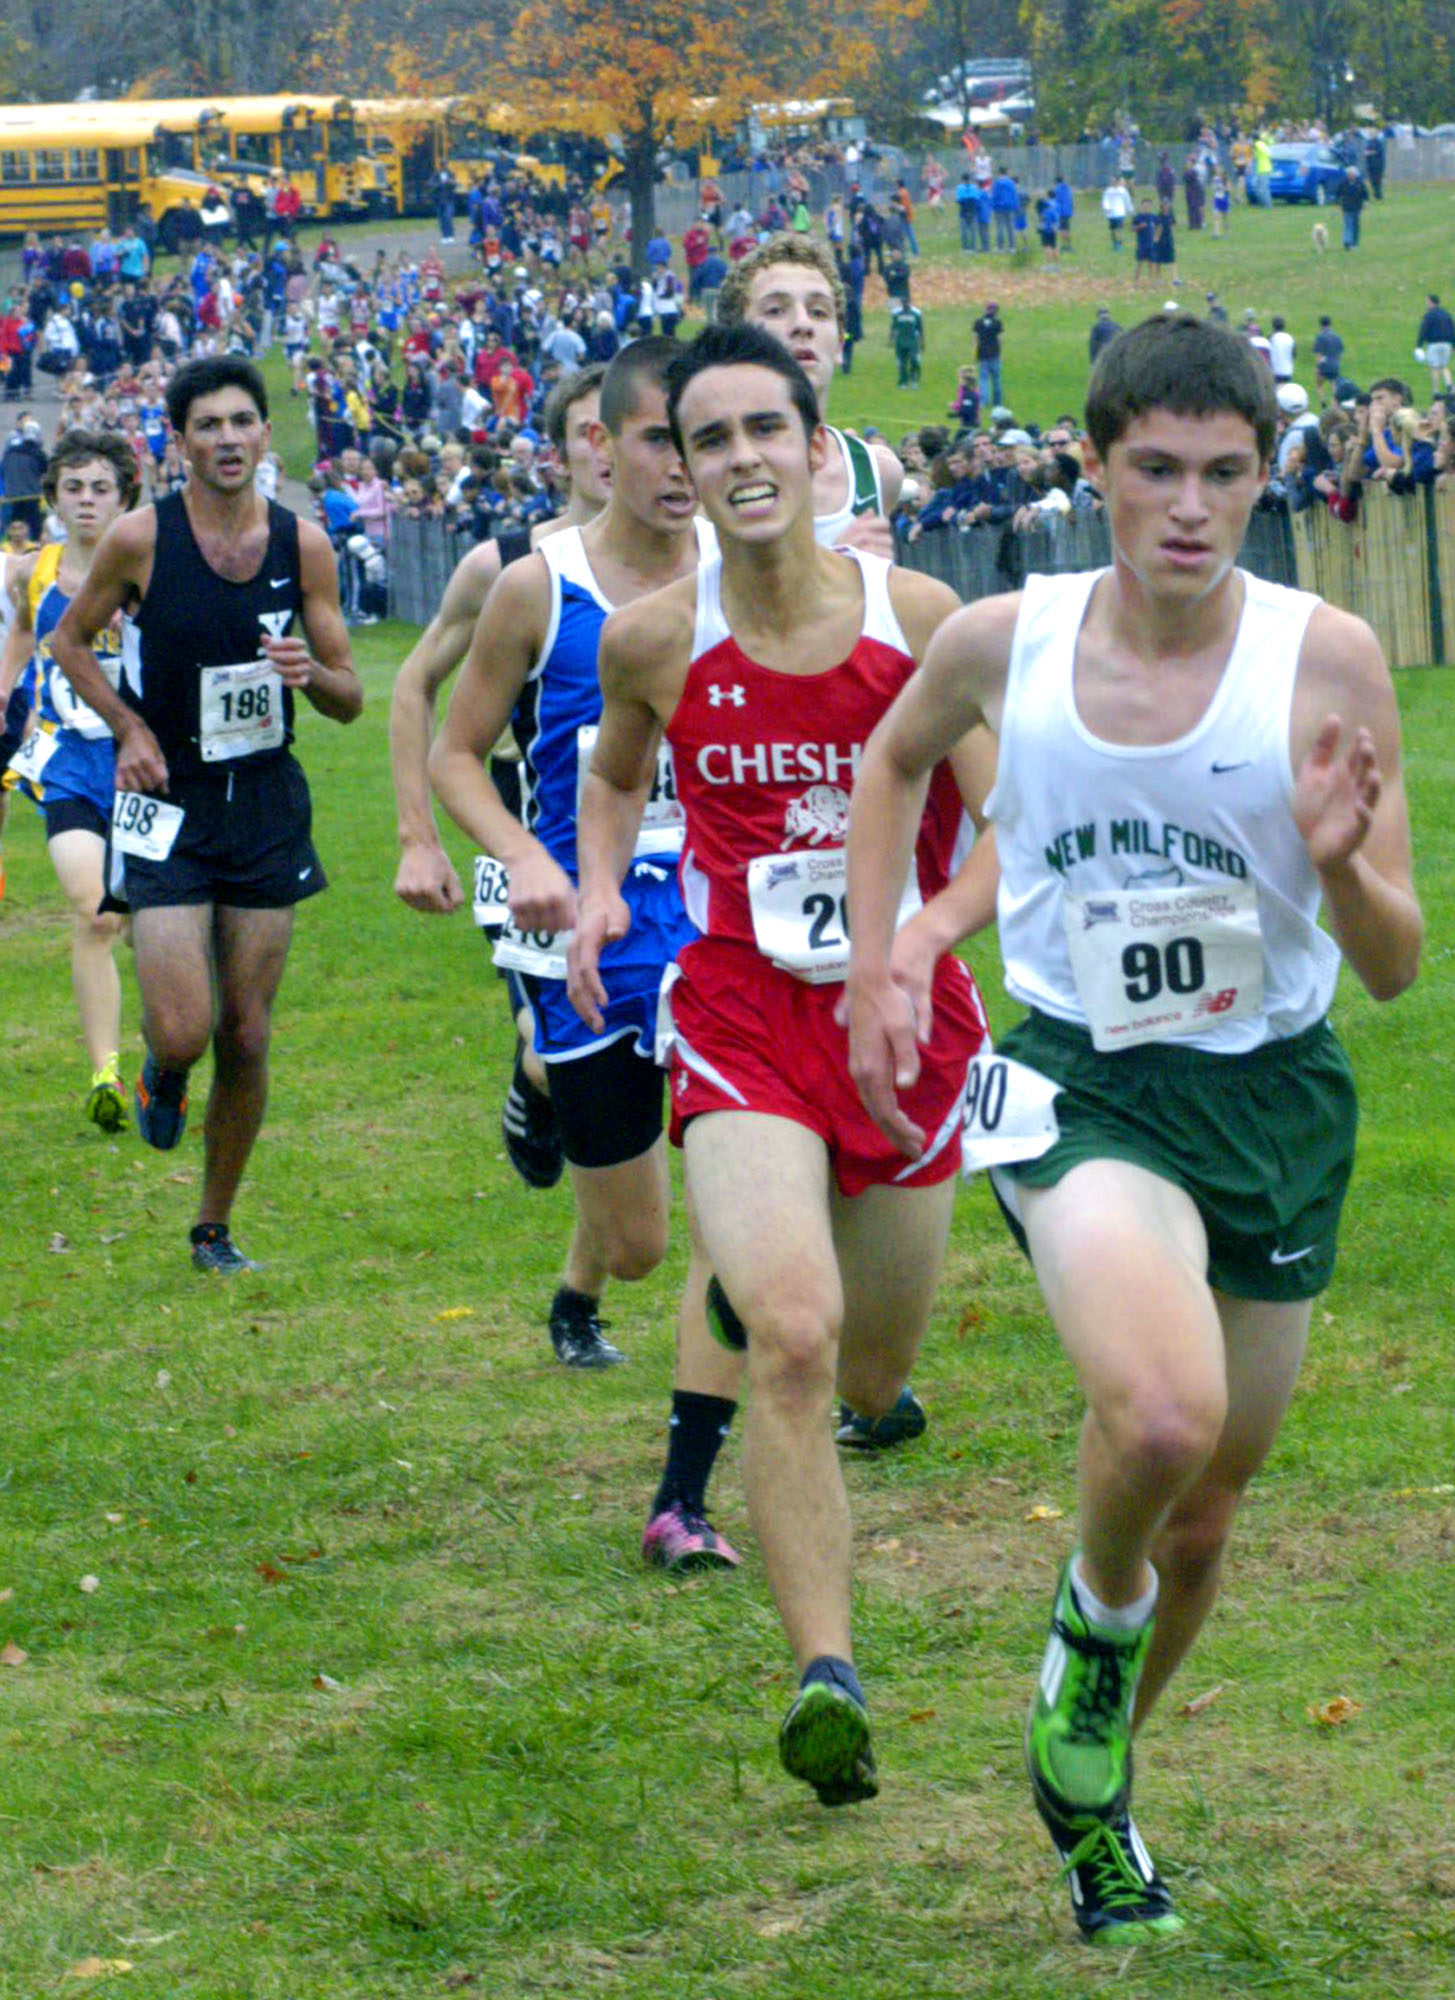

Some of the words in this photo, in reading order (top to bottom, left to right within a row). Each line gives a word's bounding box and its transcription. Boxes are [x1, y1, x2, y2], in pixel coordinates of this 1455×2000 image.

[220, 684, 270, 722] 198
[115, 795, 158, 836] 198
[1045, 822, 1095, 875] NEW
[1111, 819, 1247, 879] MILFORD
[1122, 936, 1205, 1003] 90
[962, 1062, 1008, 1131] 90
